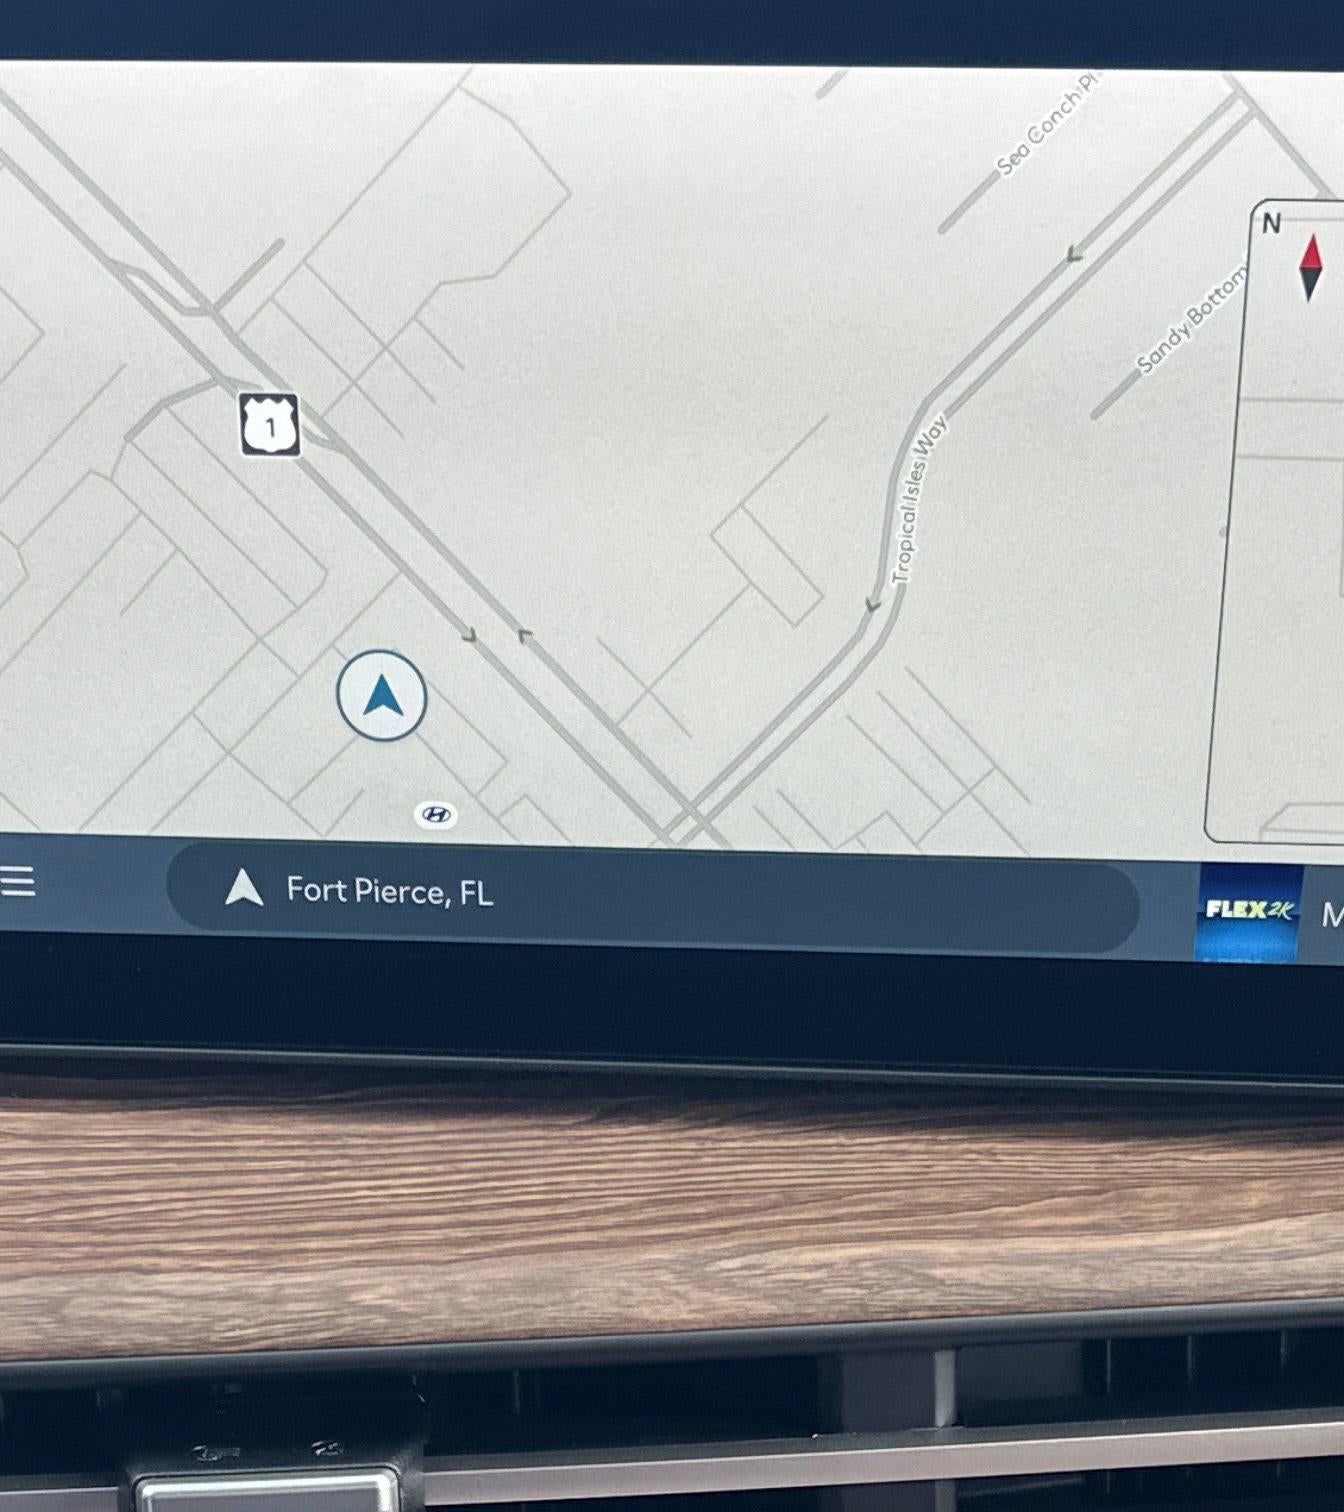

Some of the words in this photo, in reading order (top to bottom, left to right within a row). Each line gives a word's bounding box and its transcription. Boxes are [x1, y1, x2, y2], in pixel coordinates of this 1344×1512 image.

[997, 144, 1031, 176] Sea
[1028, 92, 1082, 144] Conch
[1262, 211, 1282, 234] N
[1137, 322, 1191, 374] Sandy
[265, 416, 277, 440] 1
[913, 415, 947, 456] Way
[902, 460, 927, 502] Isles
[891, 504, 917, 585] Tropical
[287, 875, 348, 903] Fort
[355, 877, 451, 910] Pierce,
[460, 879, 495, 906] FL
[1205, 898, 1270, 921] FLEX
